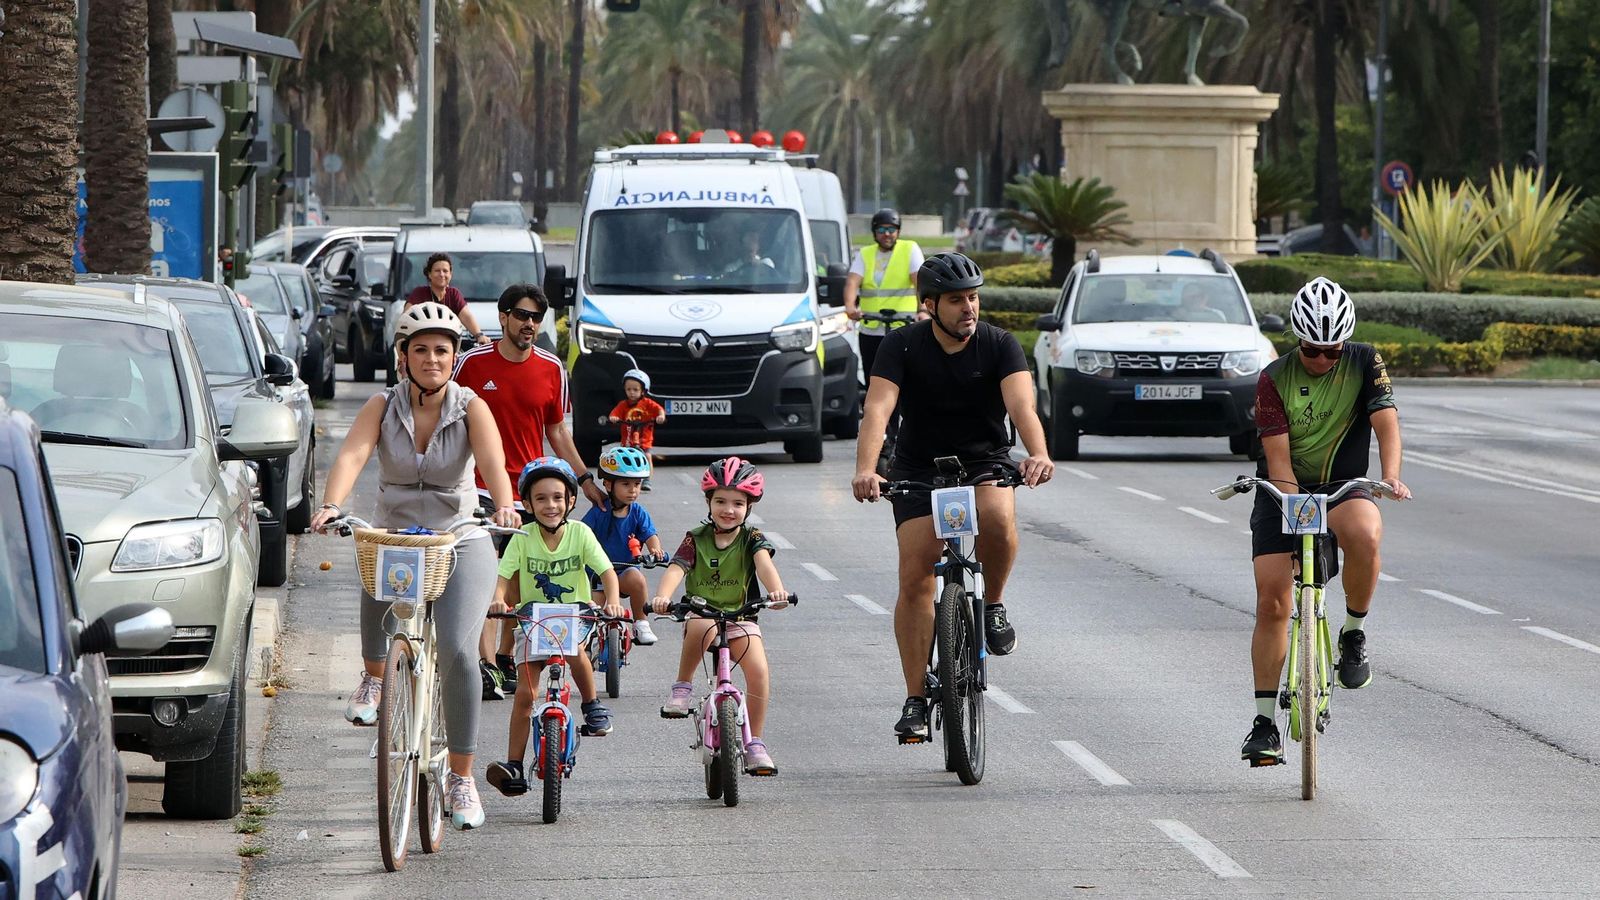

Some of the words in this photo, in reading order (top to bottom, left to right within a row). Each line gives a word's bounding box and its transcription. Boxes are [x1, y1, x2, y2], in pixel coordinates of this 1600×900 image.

[1142, 387, 1171, 398] 2014
[1175, 387, 1195, 398] JCF
[673, 402, 702, 413] 3012
[706, 402, 729, 413] MNV
[529, 557, 578, 574] GOAAAL
